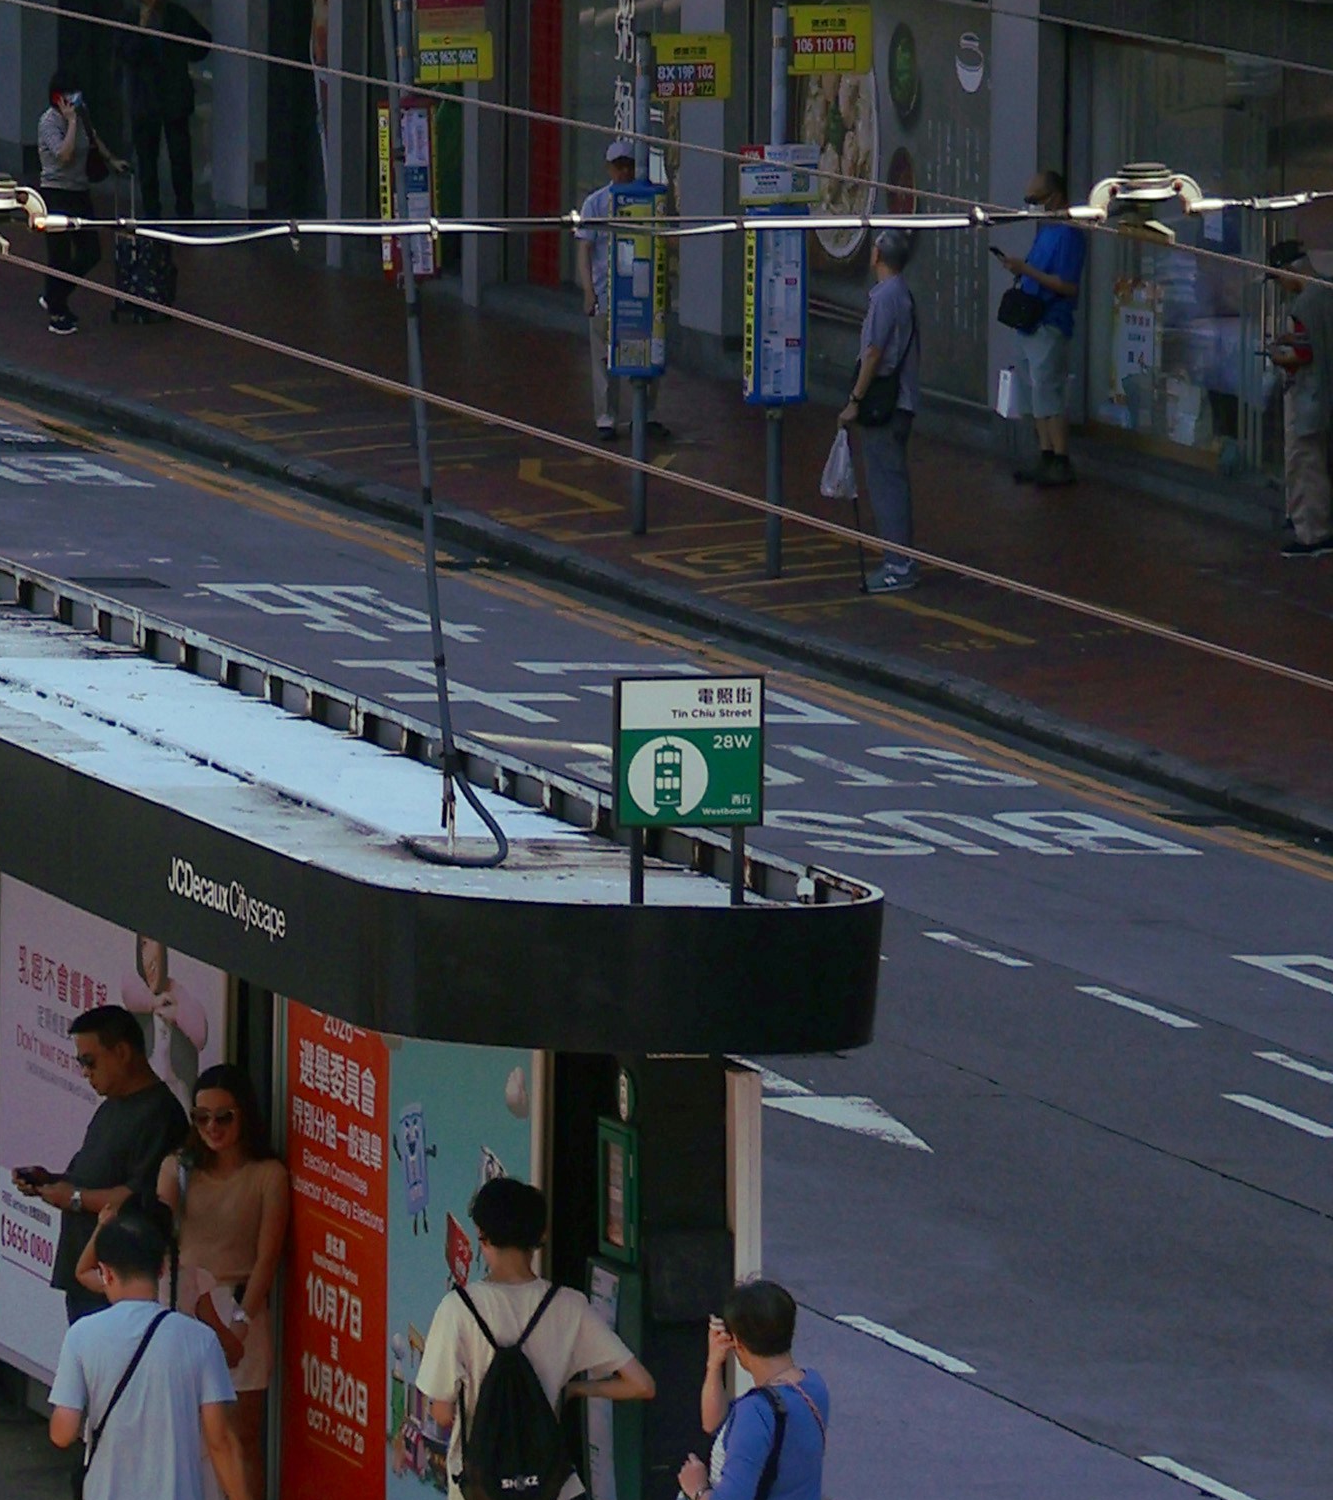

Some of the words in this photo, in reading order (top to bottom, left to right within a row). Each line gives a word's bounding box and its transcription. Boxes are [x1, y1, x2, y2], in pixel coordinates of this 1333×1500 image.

[816, 37, 835, 52] 110
[837, 37, 855, 52] 116
[657, 65, 676, 81] 8X
[696, 64, 714, 79] 102
[678, 81, 695, 96] 112
[698, 686, 752, 706] 電照街
[672, 708, 689, 720] Tin
[691, 707, 716, 721] Chiu
[719, 707, 753, 720] Street
[712, 734, 753, 750] 28W
[167, 857, 229, 914] JCDecaux
[229, 880, 286, 942] Cityscape
[298, 1037, 377, 1119] 選舉委員會
[291, 1094, 383, 1172] 界別分組一般選舉
[305, 1270, 363, 1343] 10月7日
[300, 1350, 369, 1428] 10月20日
